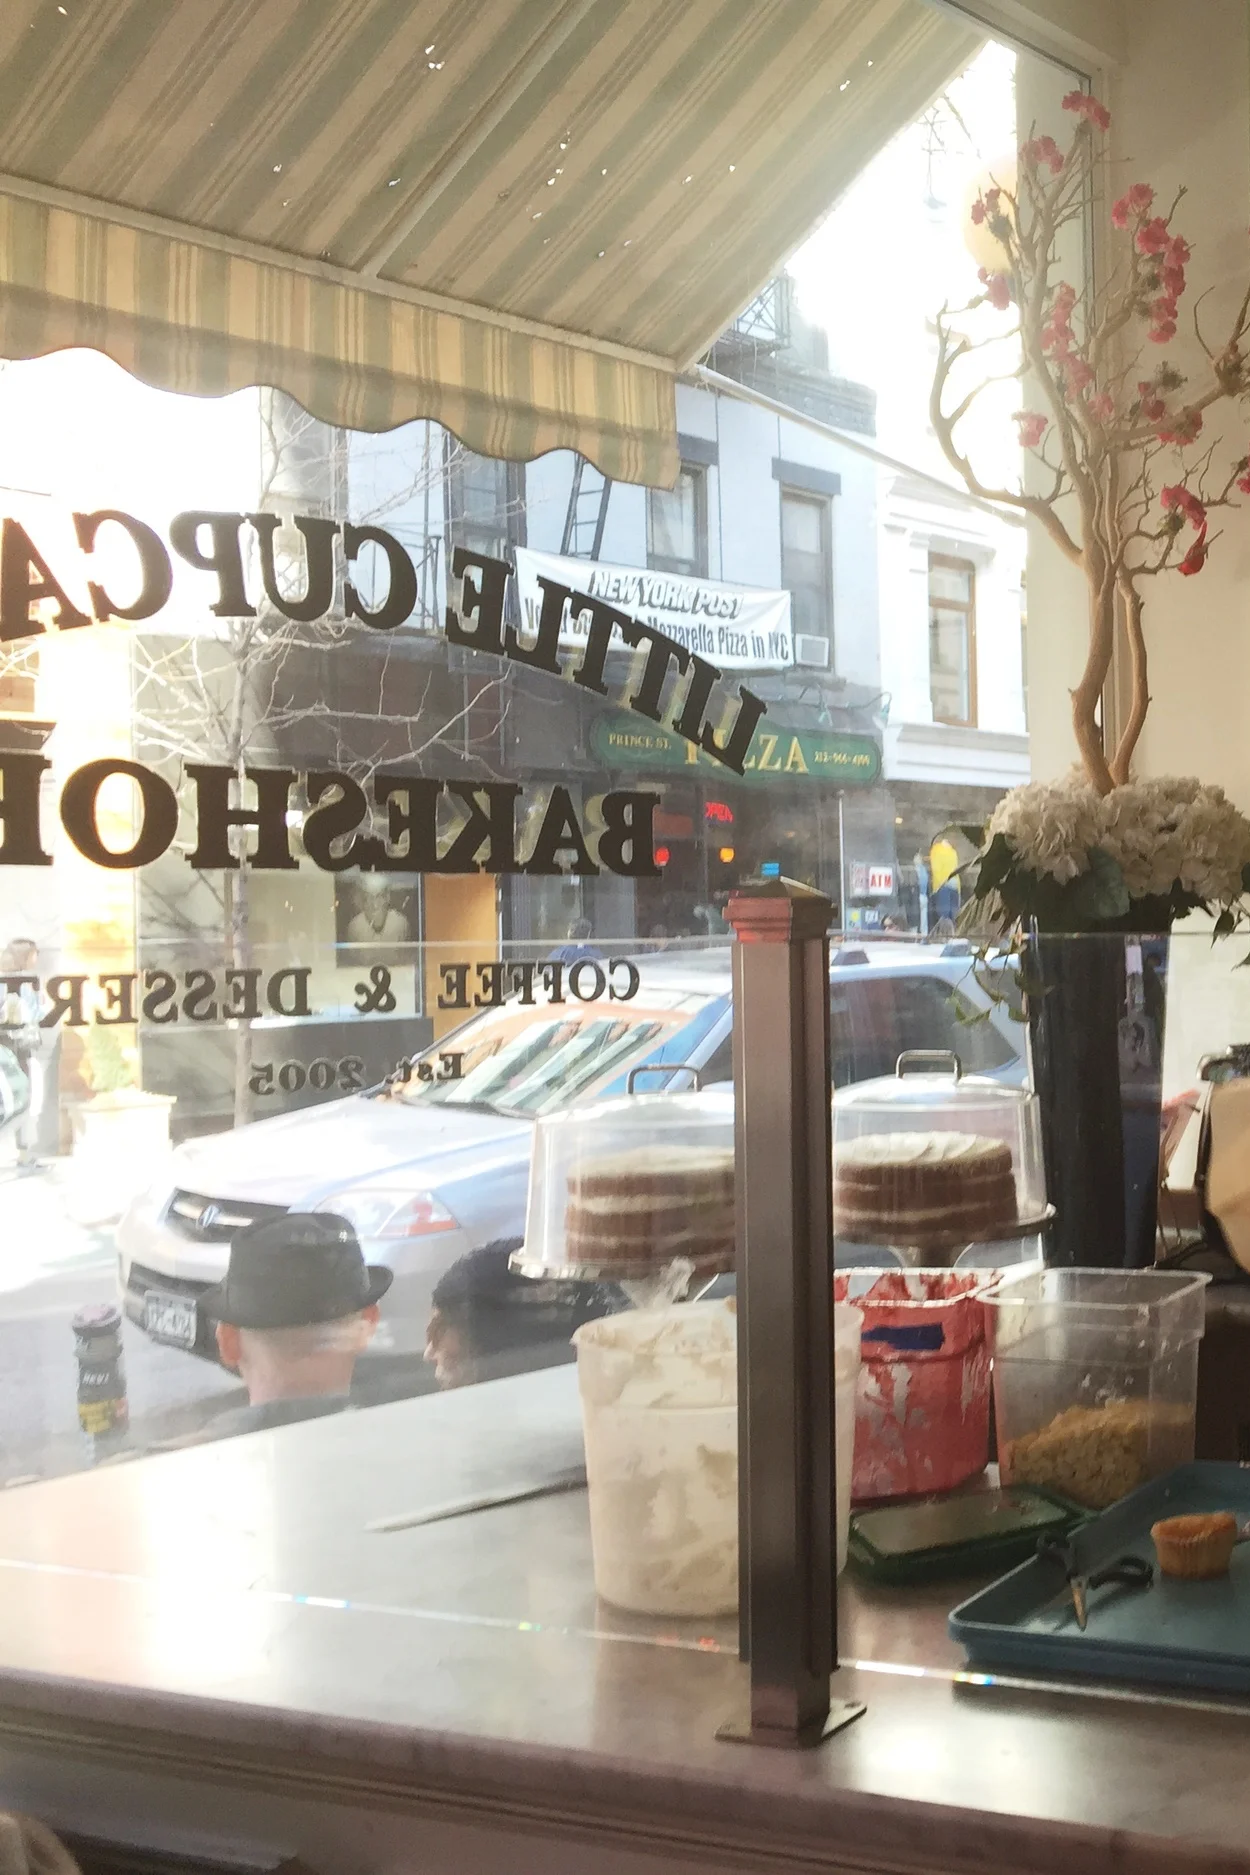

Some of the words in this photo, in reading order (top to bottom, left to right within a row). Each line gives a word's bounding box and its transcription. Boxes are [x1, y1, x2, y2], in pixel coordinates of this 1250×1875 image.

[588, 570, 641, 606] NEW
[636, 575, 694, 614] YORK
[689, 586, 744, 619] POST
[717, 630, 747, 657] Pizza
[751, 631, 764, 658] in
[609, 733, 652, 750] PRINCE
[869, 873, 893, 889] ATM
